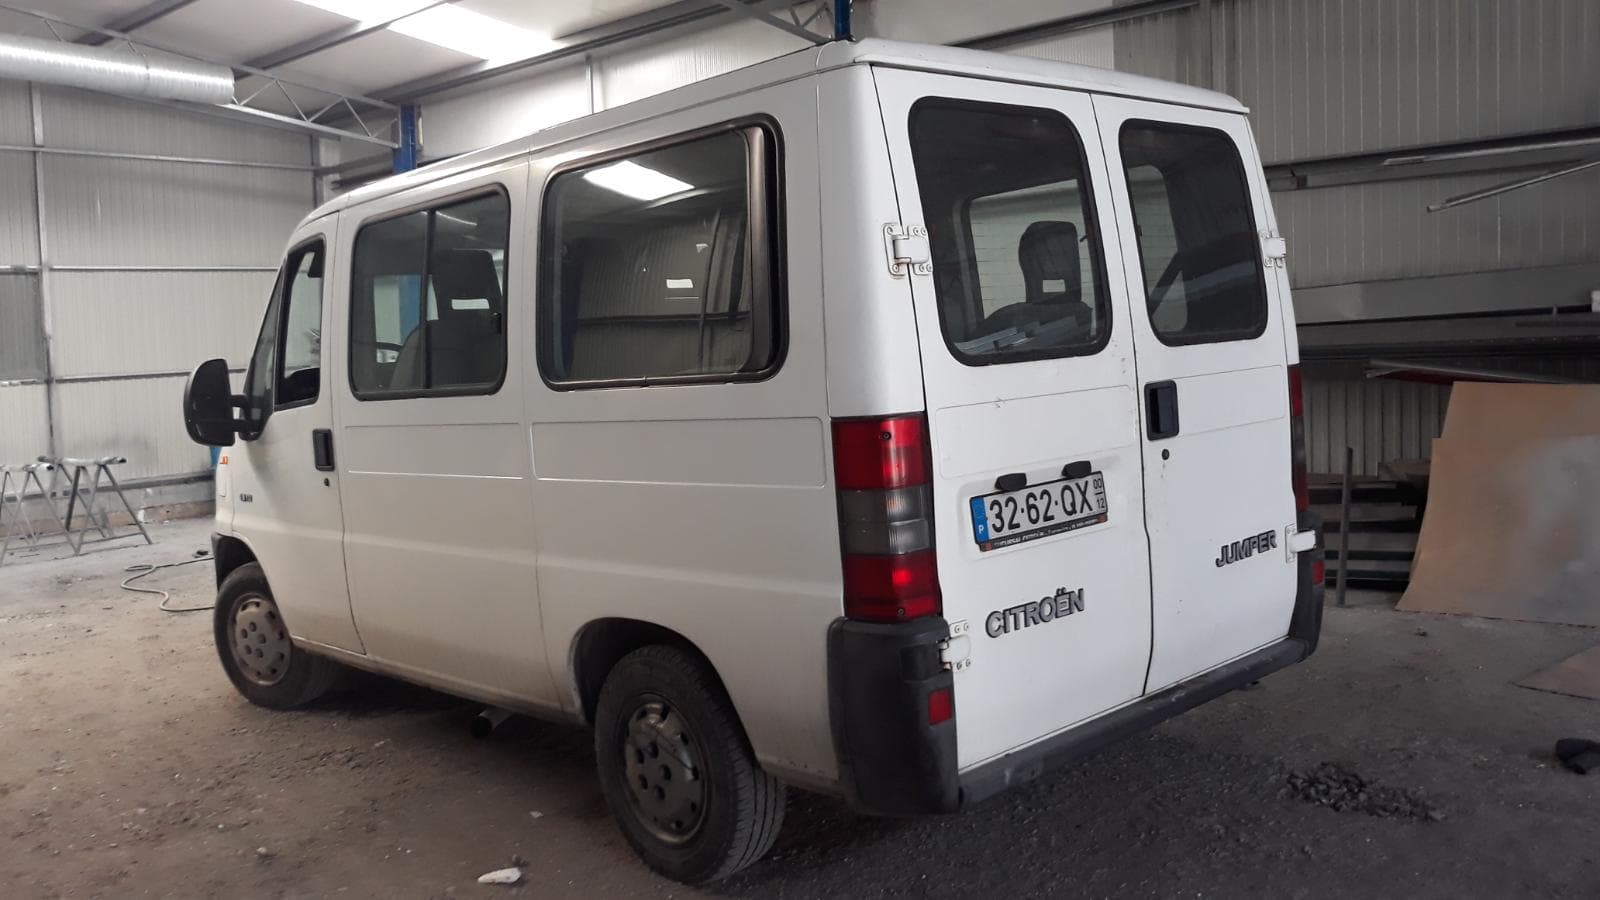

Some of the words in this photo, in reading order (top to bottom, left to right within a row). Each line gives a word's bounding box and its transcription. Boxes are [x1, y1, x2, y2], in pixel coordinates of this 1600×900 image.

[1093, 478, 1102, 489] 00
[1096, 498, 1105, 509] 12
[978, 525, 984, 534] P
[1215, 529, 1277, 567] JUMPER
[985, 586, 1085, 638] CITROËN
